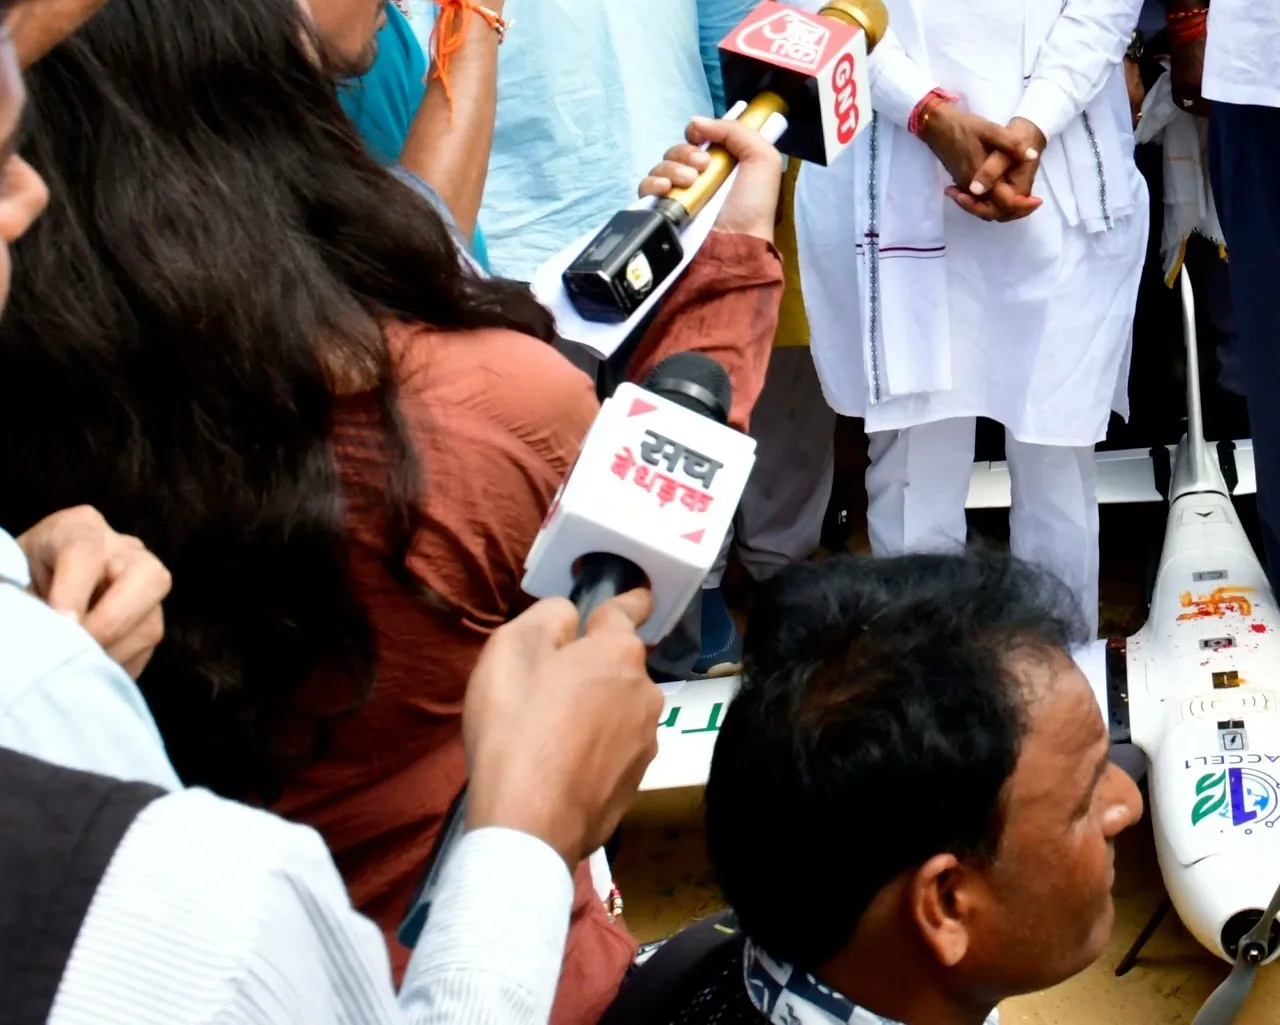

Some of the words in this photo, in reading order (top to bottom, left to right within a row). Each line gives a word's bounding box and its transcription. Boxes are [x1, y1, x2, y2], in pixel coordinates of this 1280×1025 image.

[834, 57, 858, 137] GNT
[610, 446, 714, 513] बेधड़क
[640, 429, 724, 490] सच
[1184, 753, 1280, 770] ACCEL1
